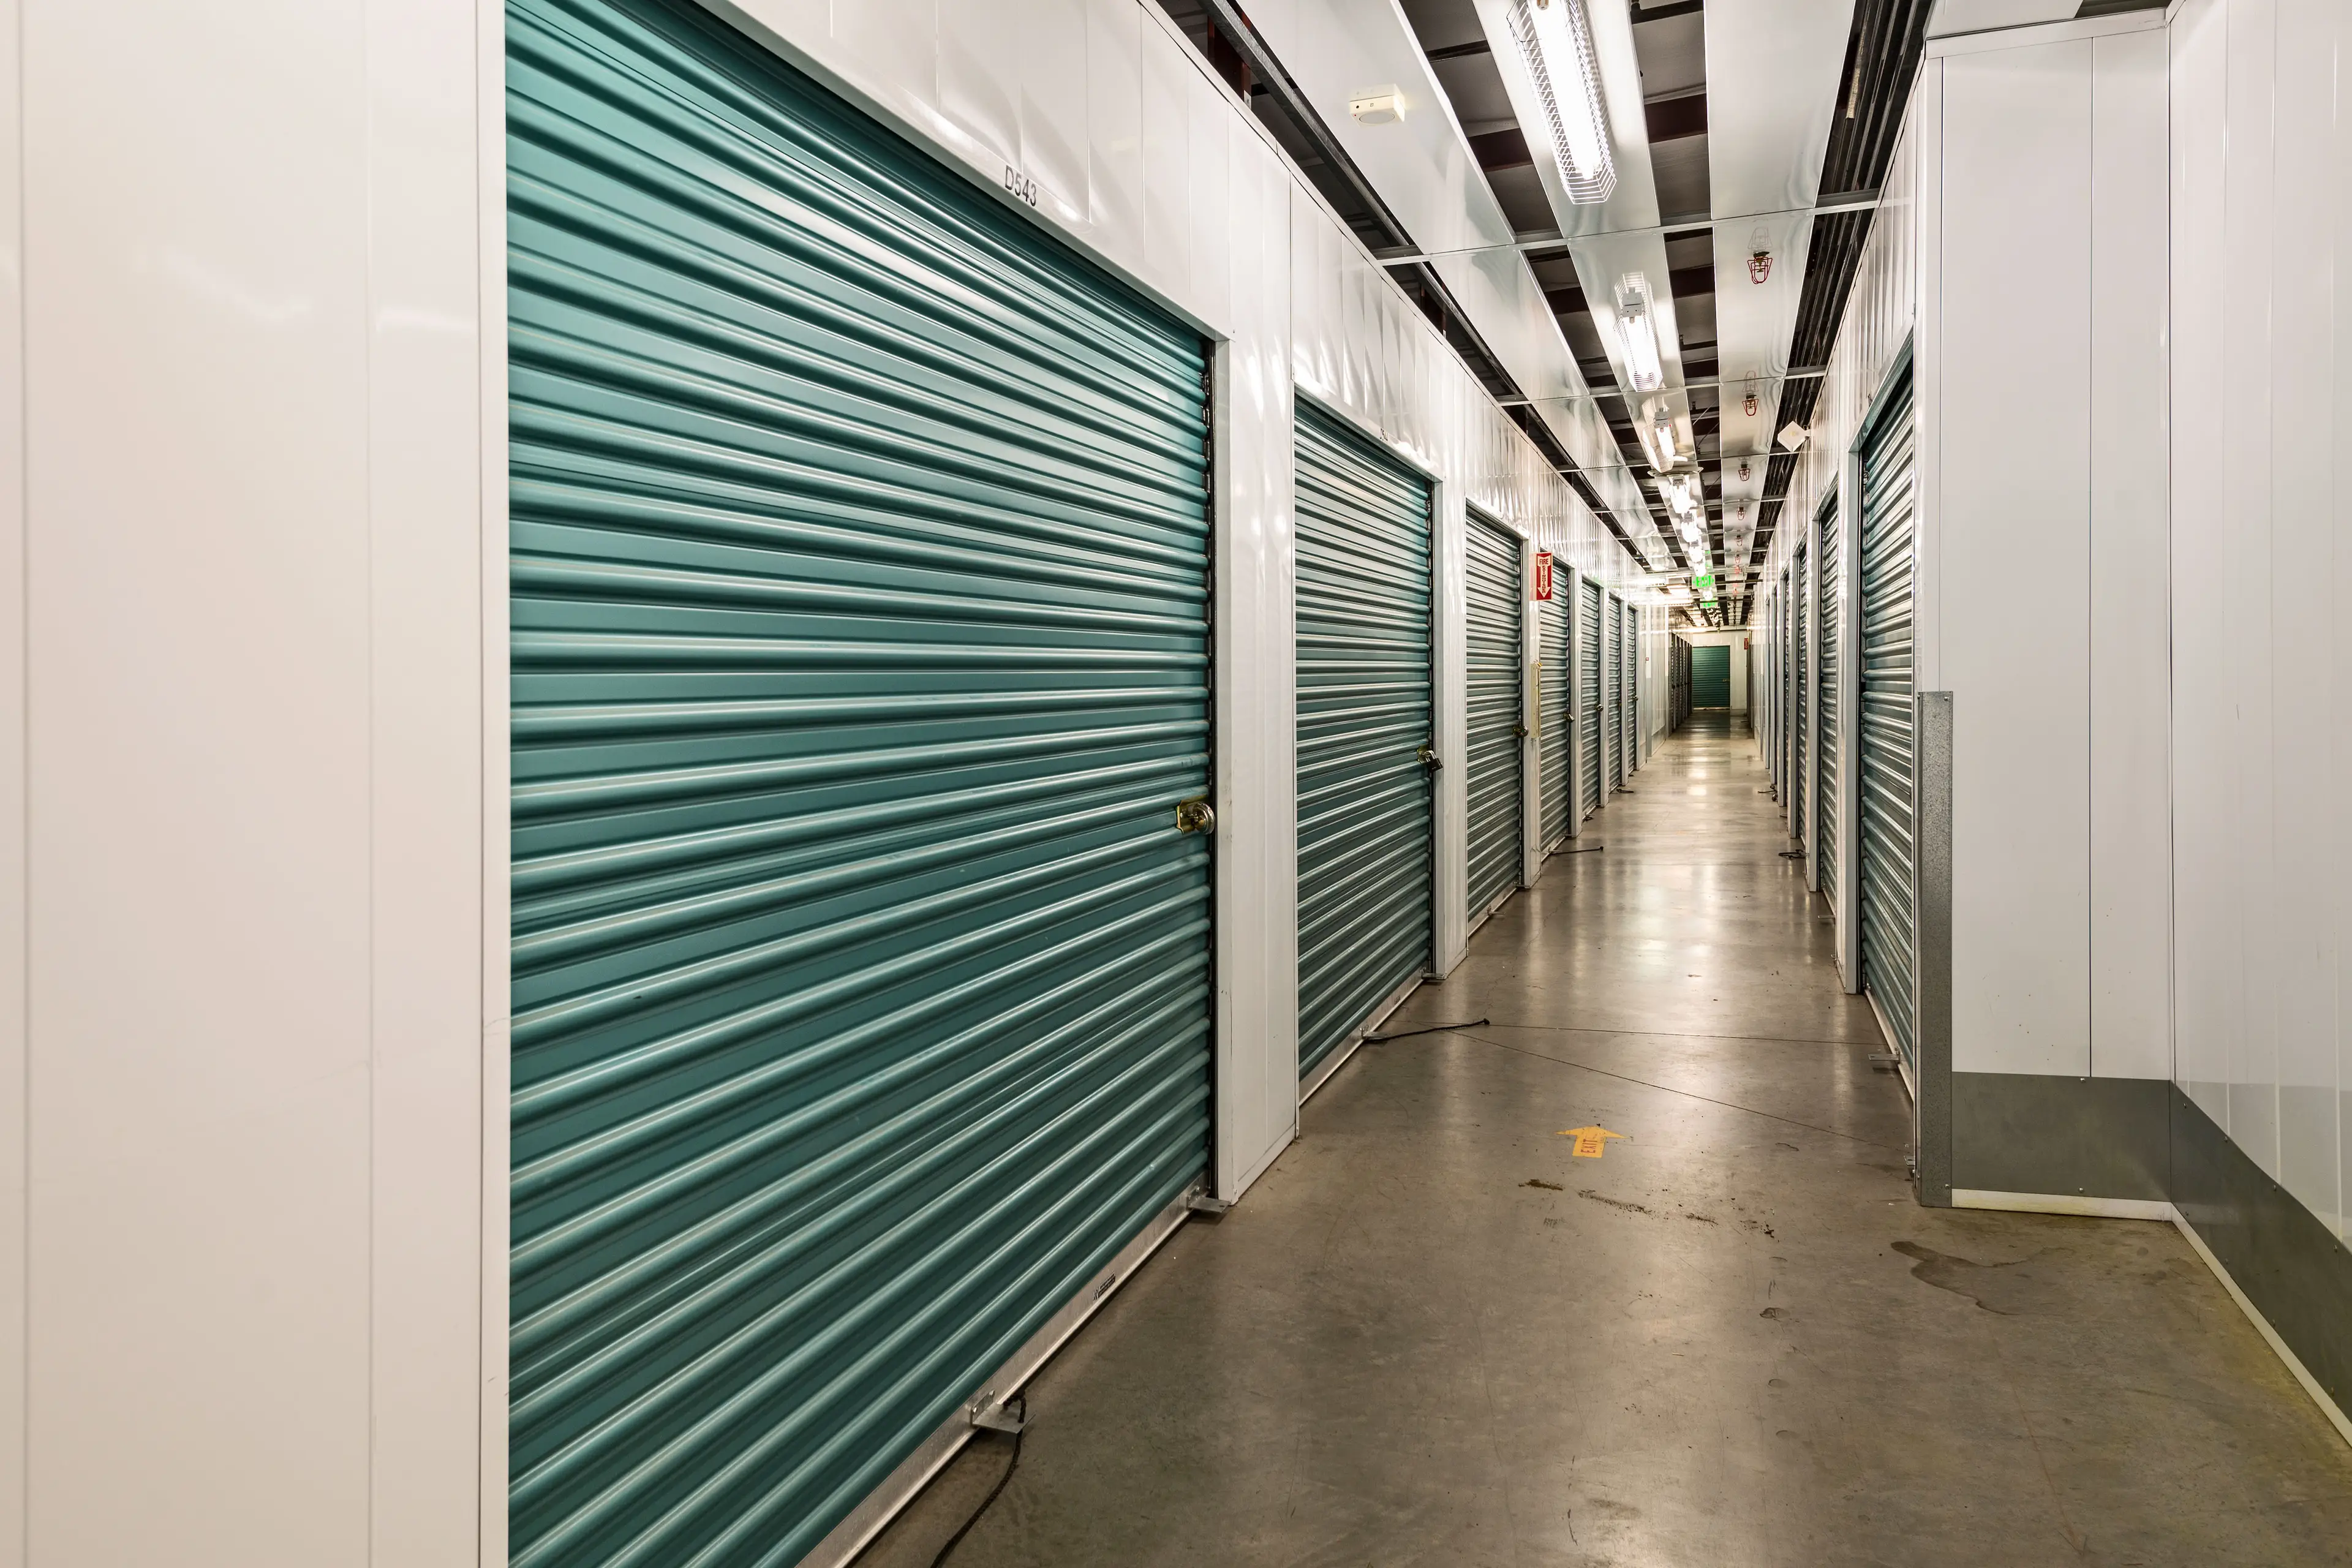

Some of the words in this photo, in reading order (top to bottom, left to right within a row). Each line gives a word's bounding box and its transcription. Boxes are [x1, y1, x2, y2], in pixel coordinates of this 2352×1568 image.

[1005, 164, 1036, 207] D543
[1696, 575, 1711, 588] EXIT
[1580, 1139, 1598, 1153] EXIT
